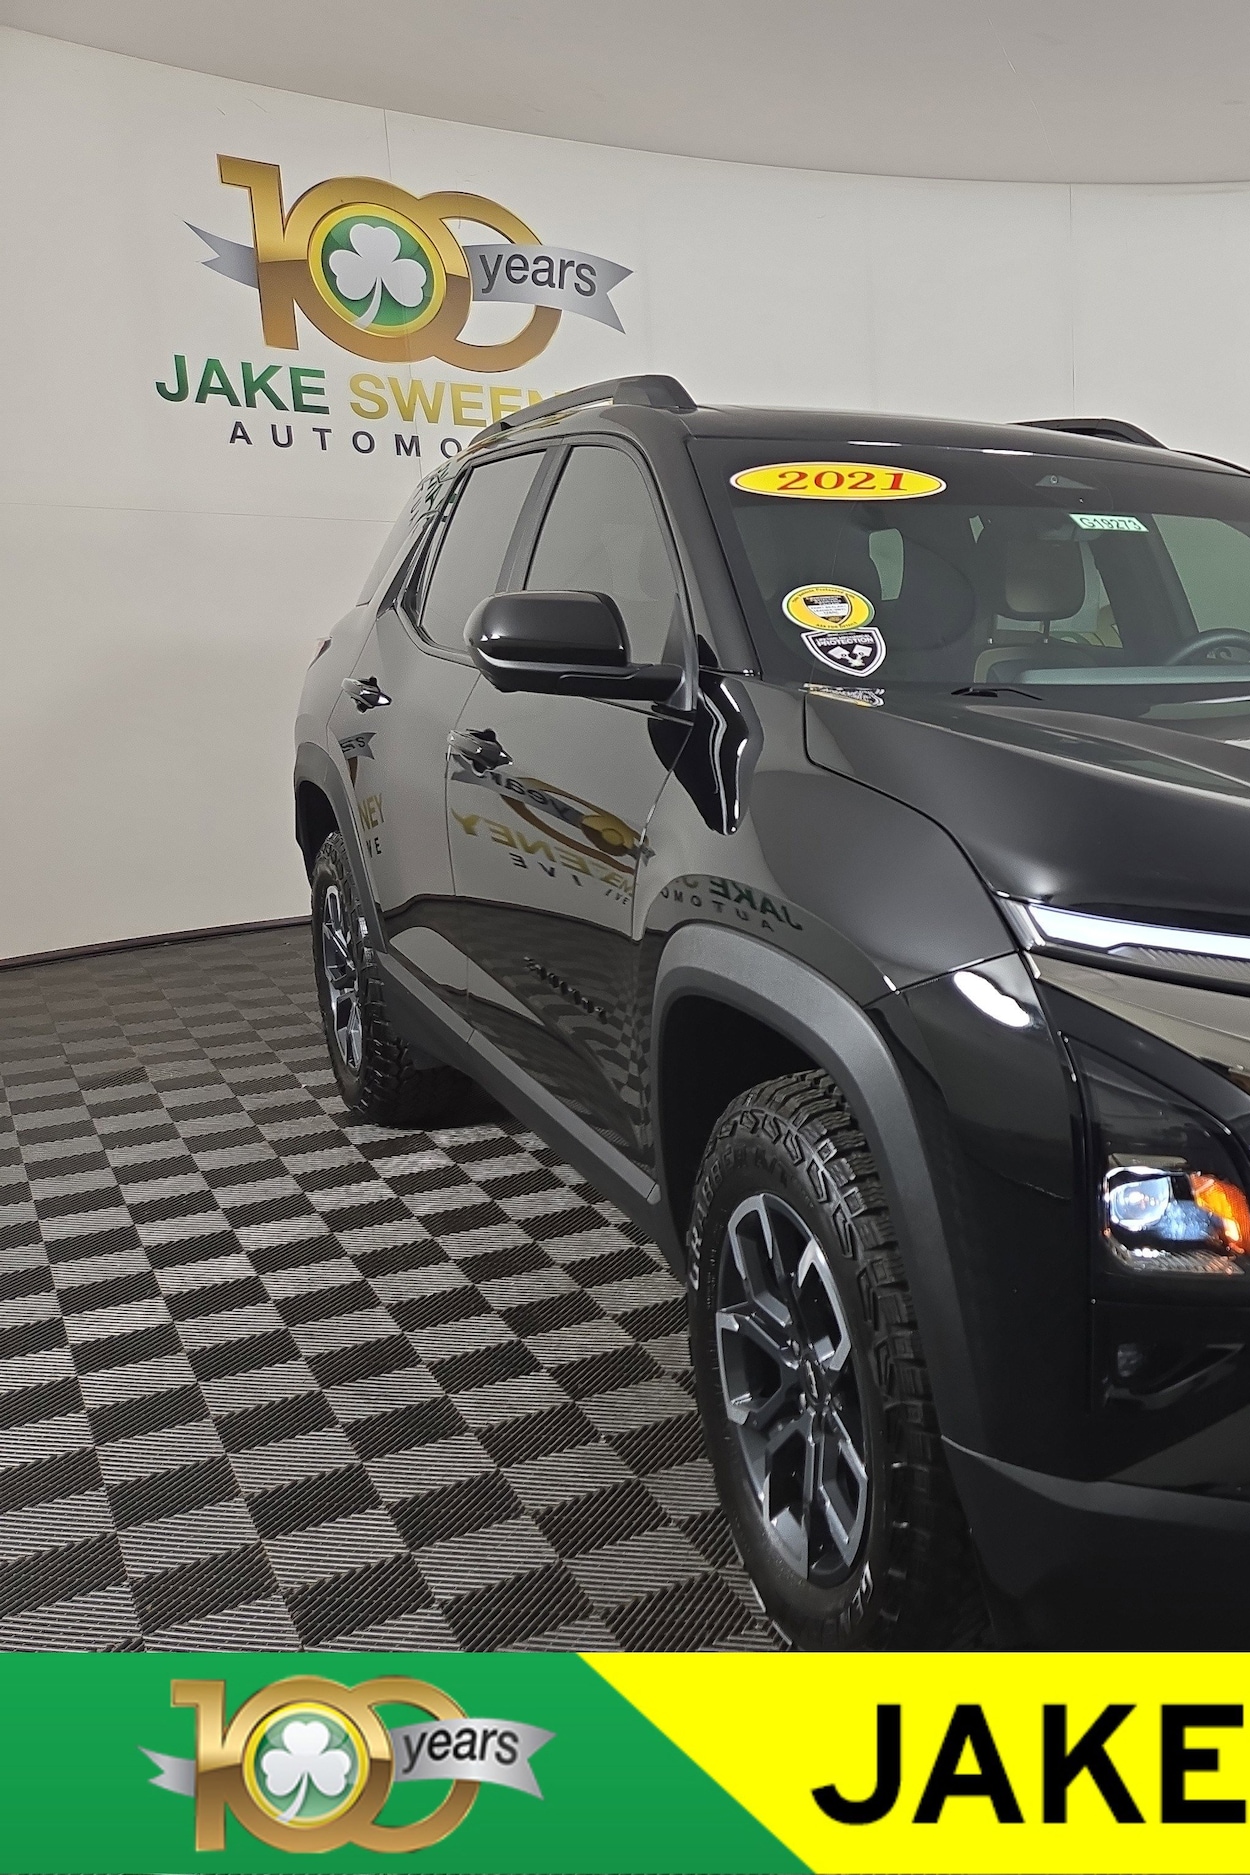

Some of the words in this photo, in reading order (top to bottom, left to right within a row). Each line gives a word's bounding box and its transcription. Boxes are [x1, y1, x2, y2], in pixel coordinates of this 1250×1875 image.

[479, 251, 597, 297] years
[155, 354, 331, 415] JAKE
[350, 373, 547, 427] SWEE
[776, 470, 908, 492] 2021
[816, 636, 875, 648] PROTECTION
